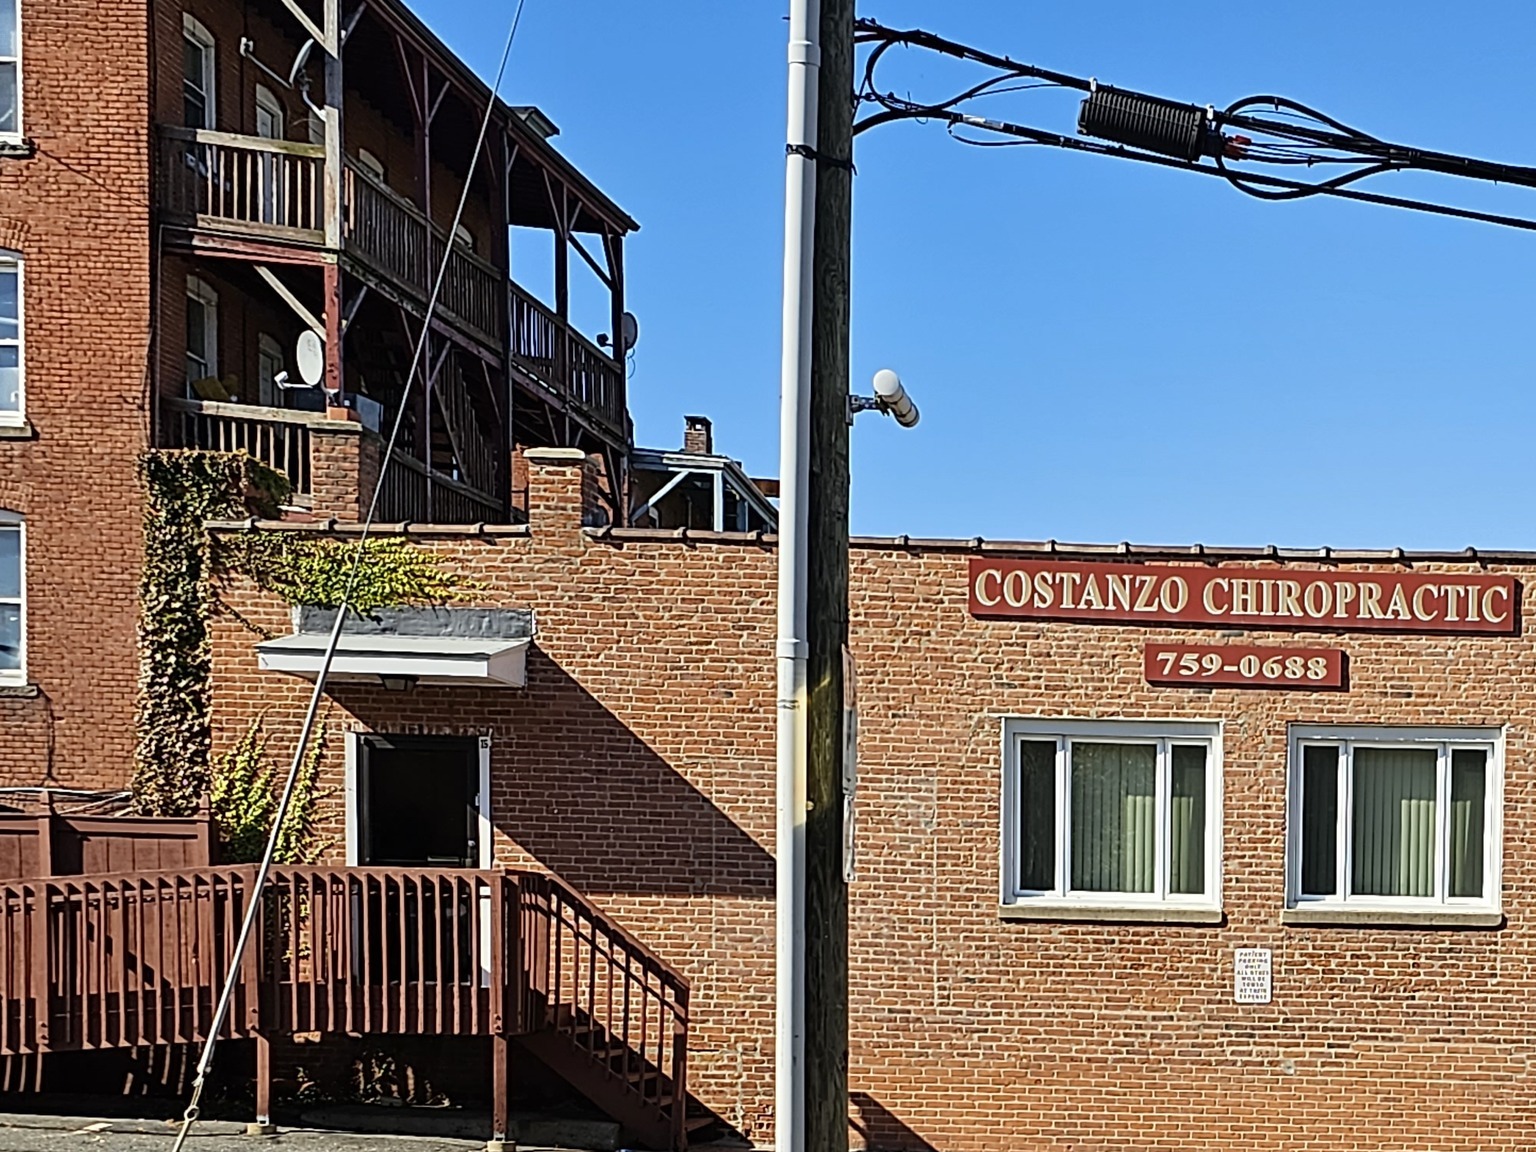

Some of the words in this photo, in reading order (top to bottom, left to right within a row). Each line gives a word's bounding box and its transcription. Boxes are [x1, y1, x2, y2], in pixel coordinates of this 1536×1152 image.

[974, 568, 1189, 614] COSTANZO
[1202, 576, 1508, 624] CHIROPRACTIC
[1155, 651, 1327, 680] 759-0688
[480, 739, 489, 749] 15
